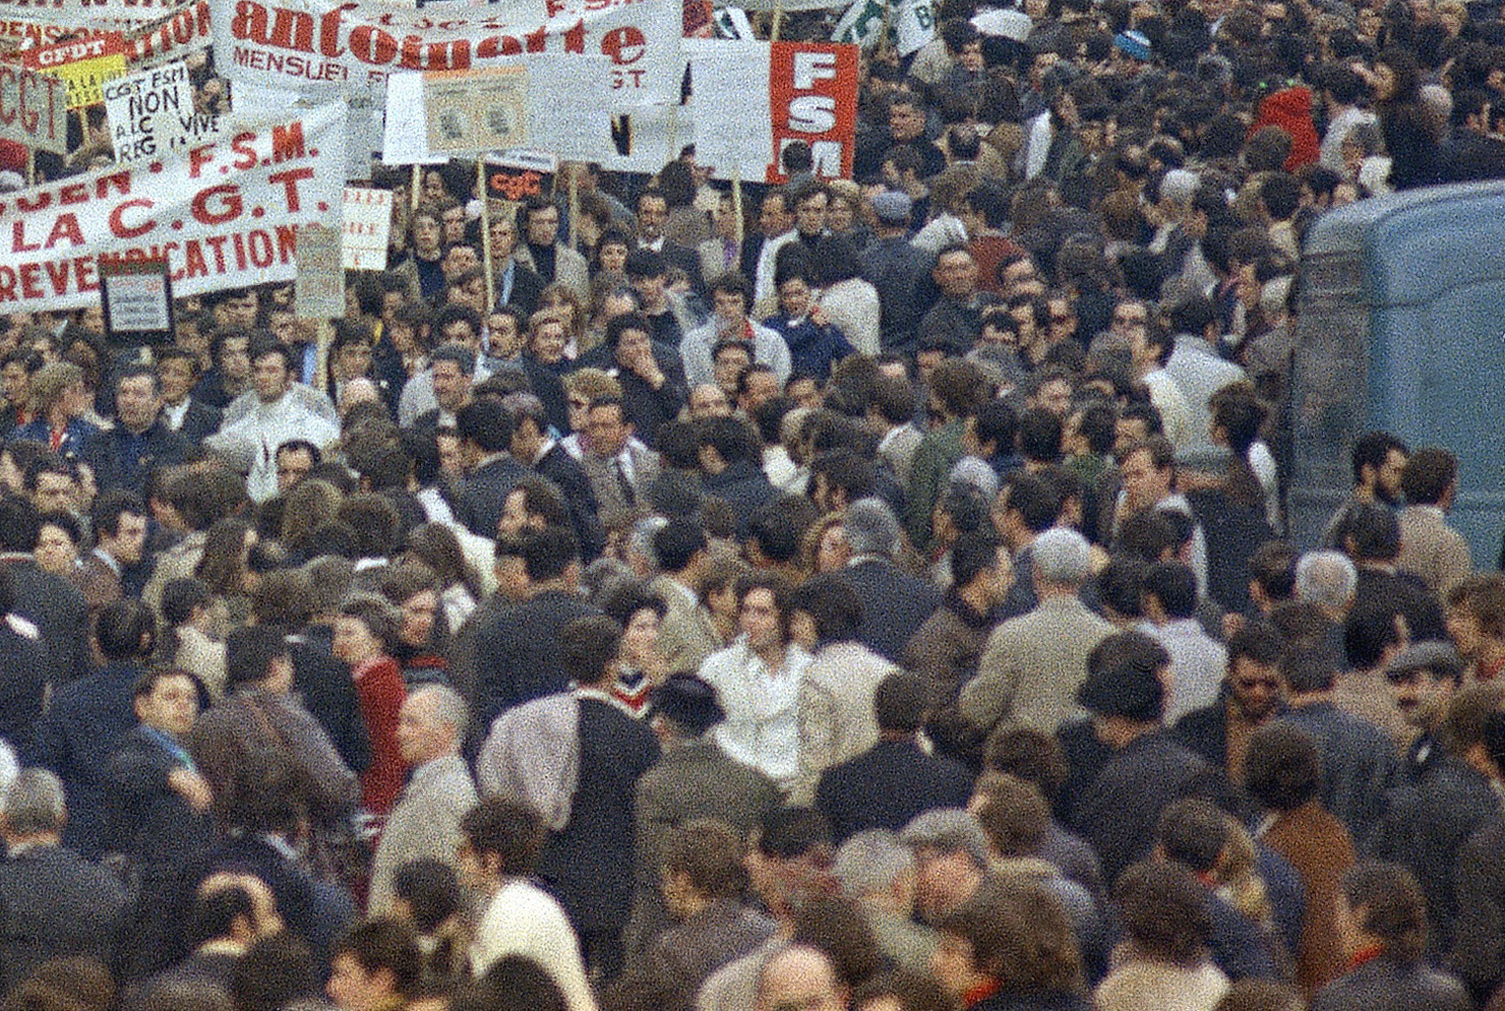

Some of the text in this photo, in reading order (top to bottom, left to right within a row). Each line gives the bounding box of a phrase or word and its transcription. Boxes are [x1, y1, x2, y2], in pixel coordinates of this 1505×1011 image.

[38, 39, 106, 66] CFDT
[103, 78, 146, 102] CGT
[127, 84, 180, 122] NON
[189, 120, 319, 180] F.S.M.
[11, 212, 87, 251] LA
[108, 168, 329, 239] C.G.T.
